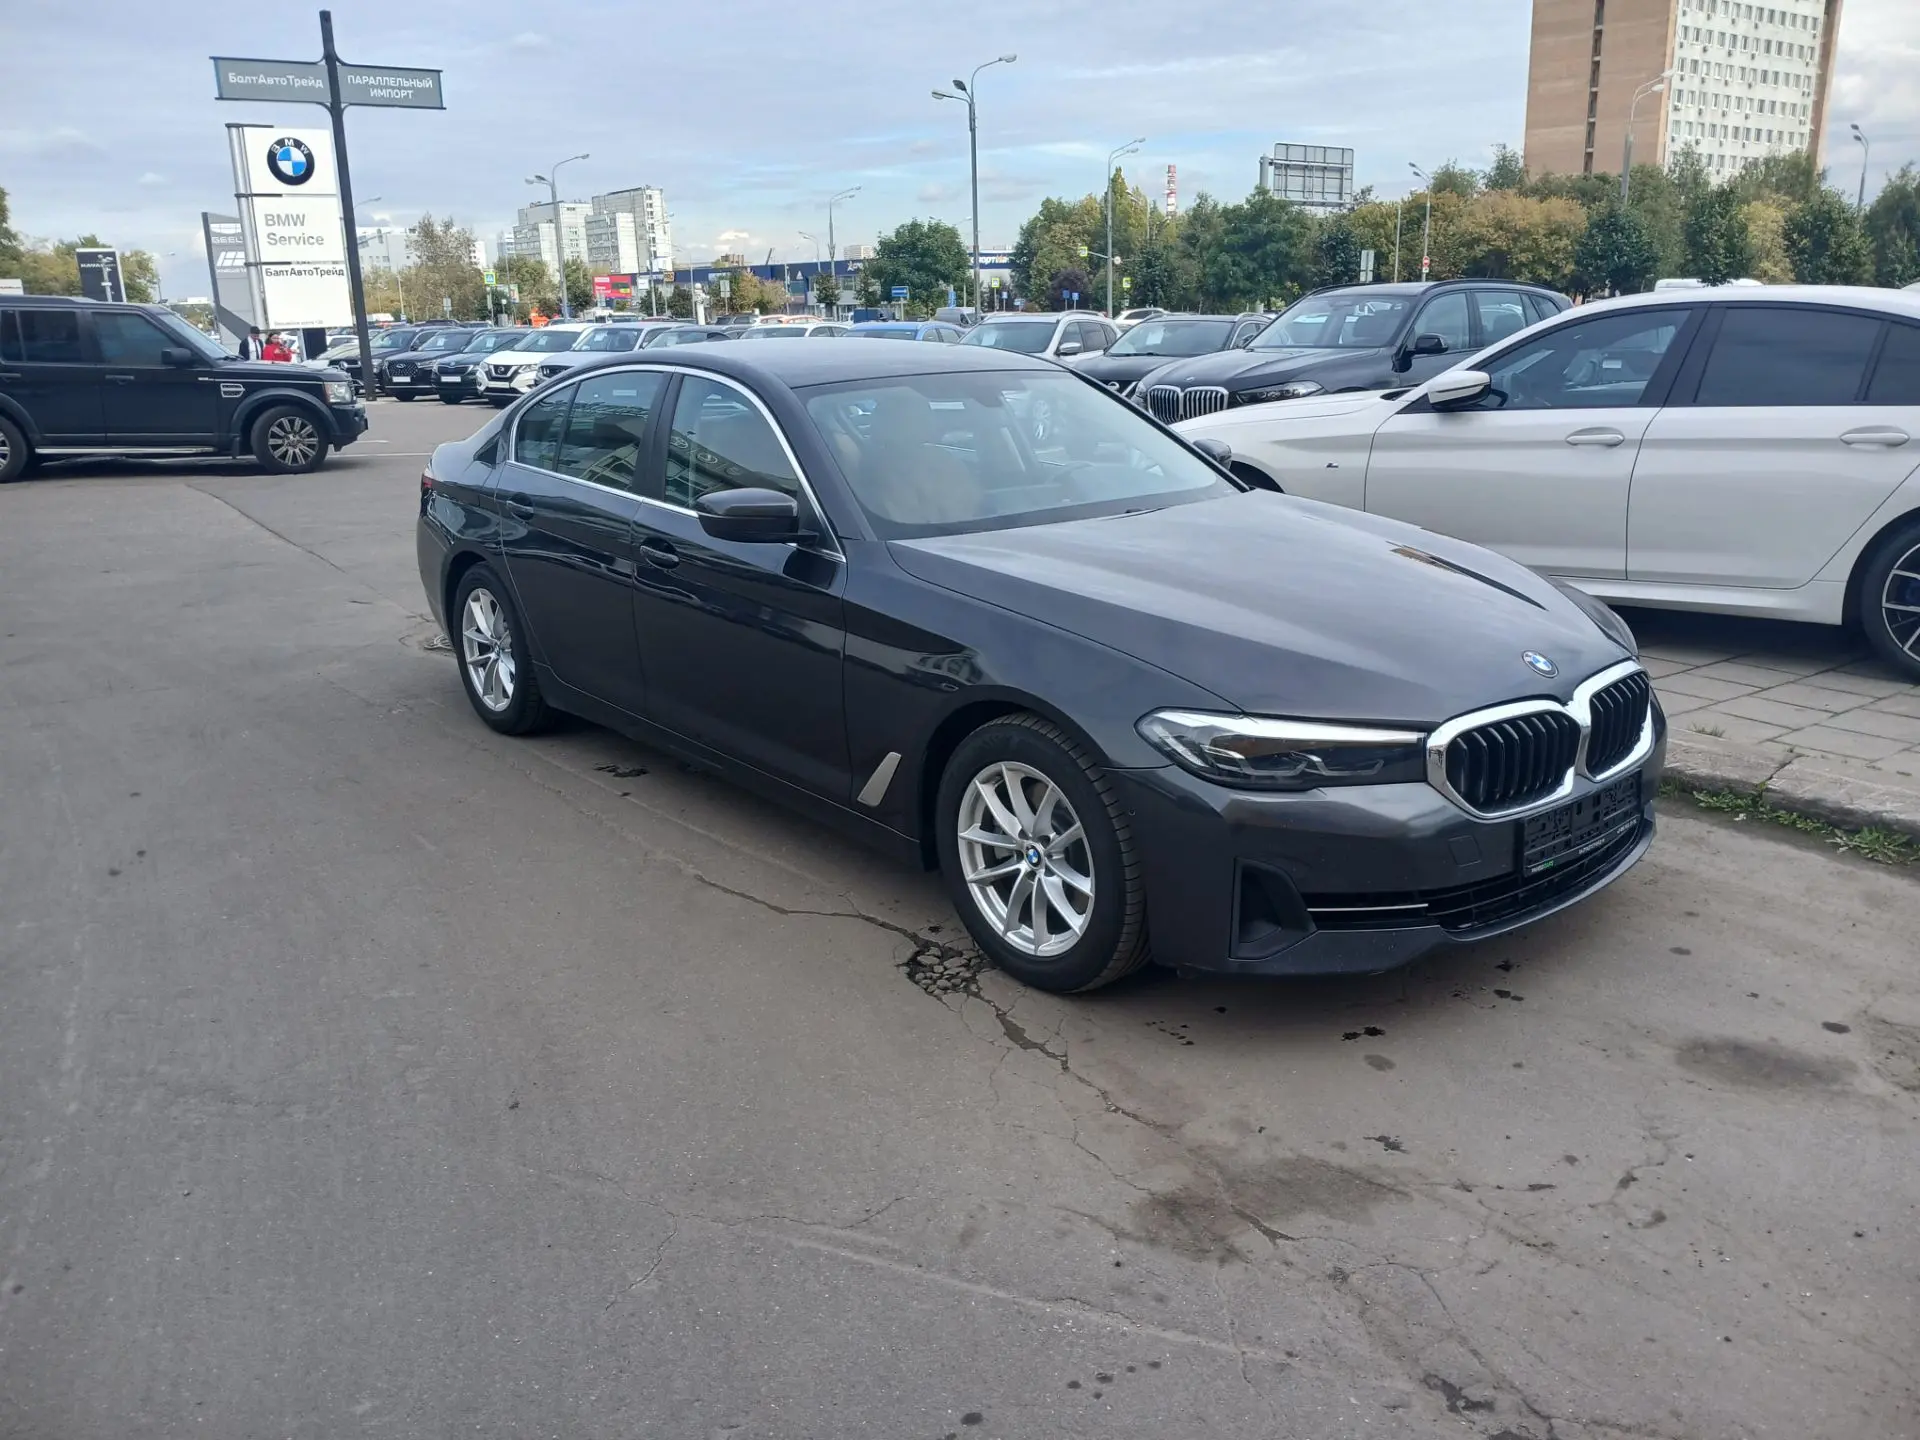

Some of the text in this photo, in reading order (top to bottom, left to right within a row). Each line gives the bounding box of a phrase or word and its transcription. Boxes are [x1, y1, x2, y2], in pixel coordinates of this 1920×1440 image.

[228, 72, 324, 88] БалтАвтоТрейд
[347, 75, 433, 89] ПАРАЛЛЕЛЬНЫЙ
[370, 88, 414, 99] ИМПОРТ
[270, 138, 310, 155] BMW
[264, 213, 306, 227] BMW
[266, 232, 325, 246] Service
[265, 266, 345, 278] БалтАвтоТрейд
